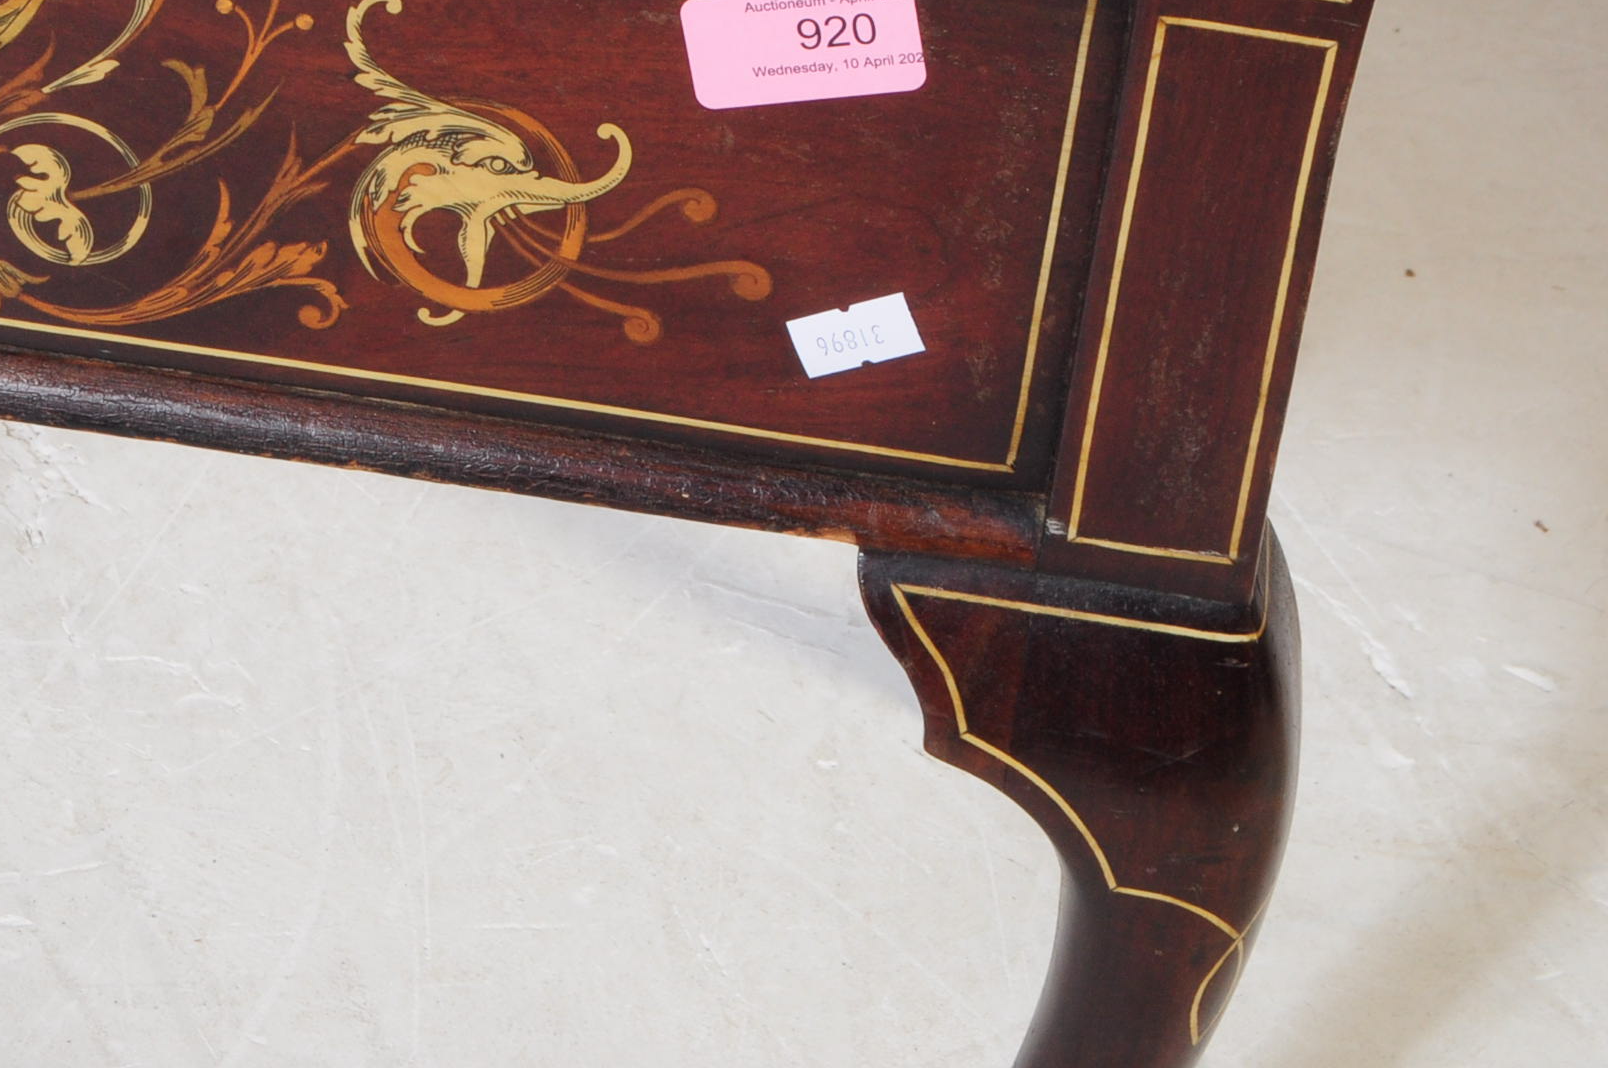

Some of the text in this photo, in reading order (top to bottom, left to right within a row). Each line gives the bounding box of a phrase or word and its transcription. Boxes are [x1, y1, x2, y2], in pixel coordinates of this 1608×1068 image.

[797, 13, 877, 50] 920
[752, 61, 838, 78] Wednesday,
[843, 58, 859, 69] 10
[863, 54, 894, 68] April
[816, 324, 885, 356] 31896
